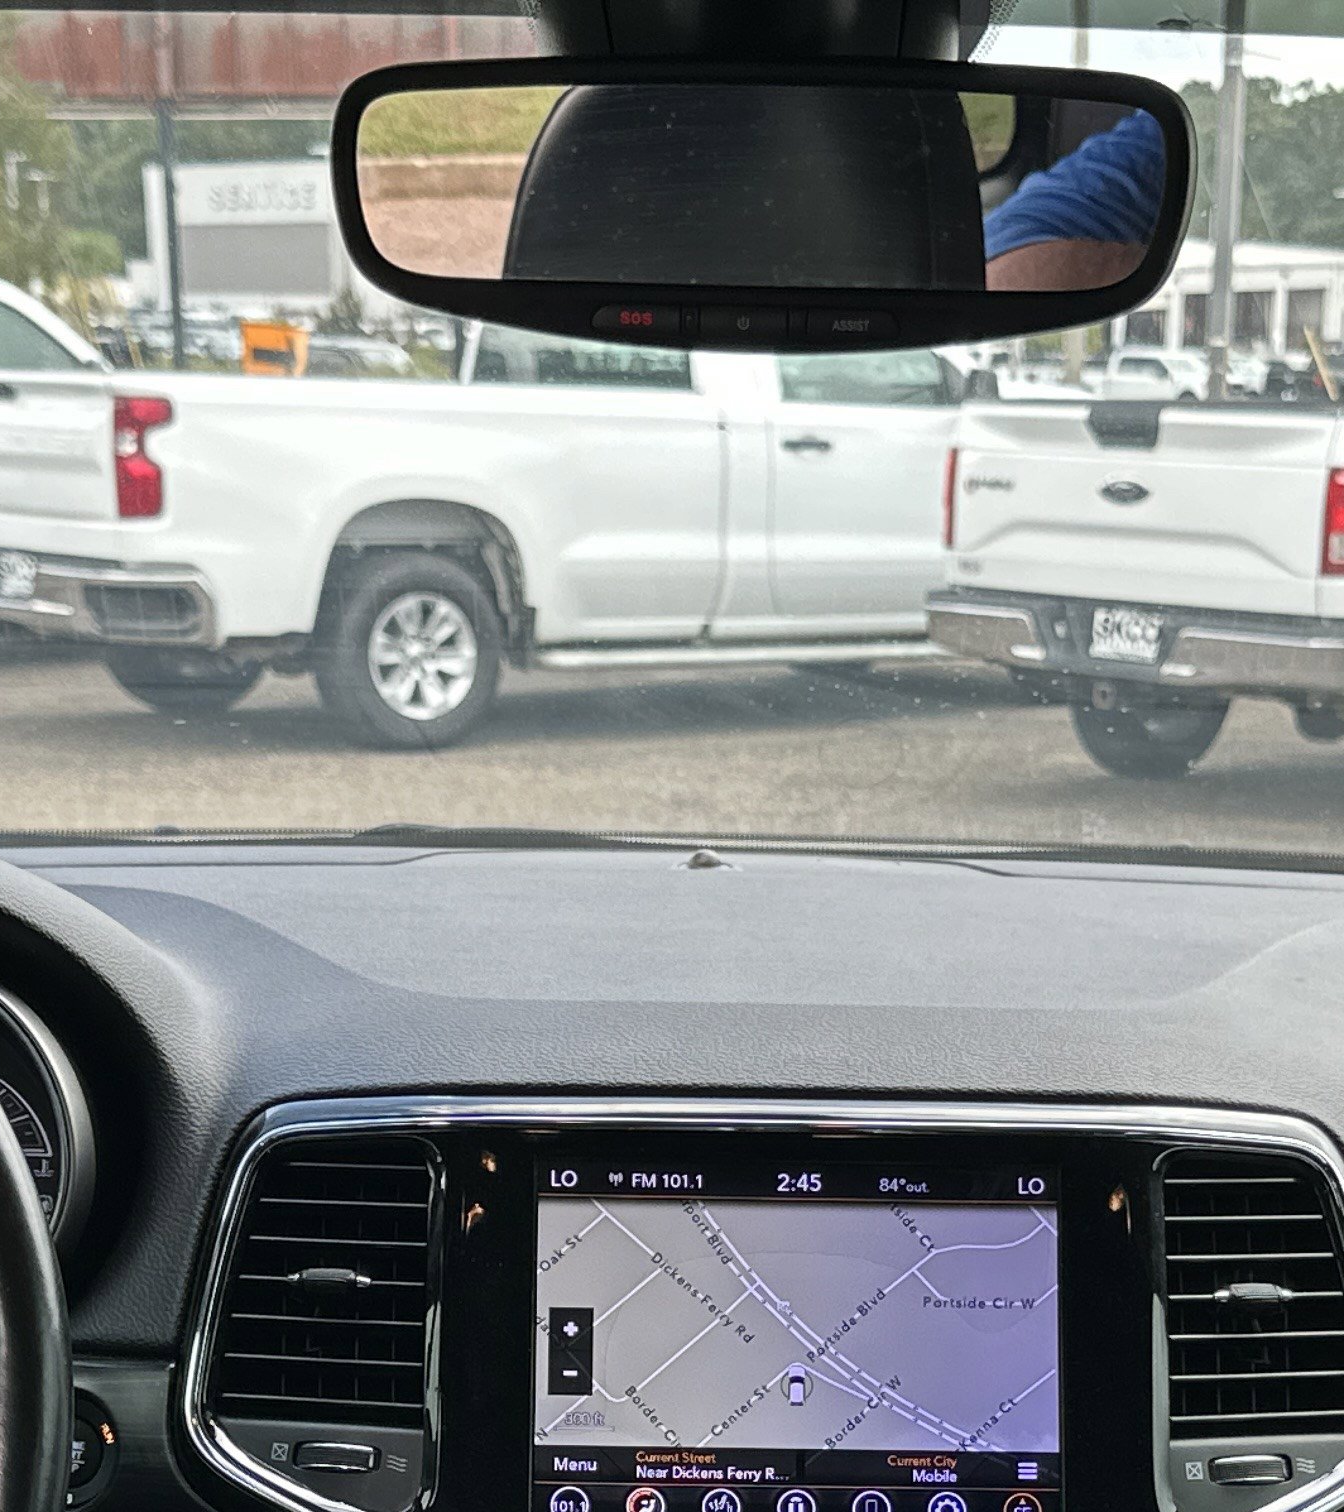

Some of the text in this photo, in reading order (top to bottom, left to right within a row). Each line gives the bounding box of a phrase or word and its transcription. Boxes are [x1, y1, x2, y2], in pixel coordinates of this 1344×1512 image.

[619, 311, 653, 325] SOS
[832, 319, 869, 332] ASSIST
[550, 1169, 579, 1188] LO
[631, 1172, 704, 1190] FM 101.1
[776, 1172, 823, 1193] 2:45
[1017, 1176, 1045, 1196] LO
[707, 1233, 734, 1266] Blvd
[918, 1232, 936, 1253] Ct
[539, 1232, 583, 1273] Oak St
[651, 1251, 756, 1345] Dickens Ferry Rd
[922, 1295, 1036, 1310] Portside Cir W
[806, 1287, 888, 1363] Portside Blvd
[624, 1384, 664, 1430] Border
[711, 1384, 771, 1437] Center St
[824, 1410, 867, 1450] Border
[885, 1374, 903, 1392] W
[998, 1397, 1018, 1415] Ct
[592, 1411, 605, 1426] ft
[553, 1457, 597, 1472] Menu
[635, 1450, 716, 1465] Current Street
[886, 1454, 957, 1470] Current City
[635, 1465, 668, 1479] Near
[671, 1466, 724, 1480] Dickens
[726, 1467, 762, 1483] Ferry
[912, 1469, 957, 1484] Mobile
